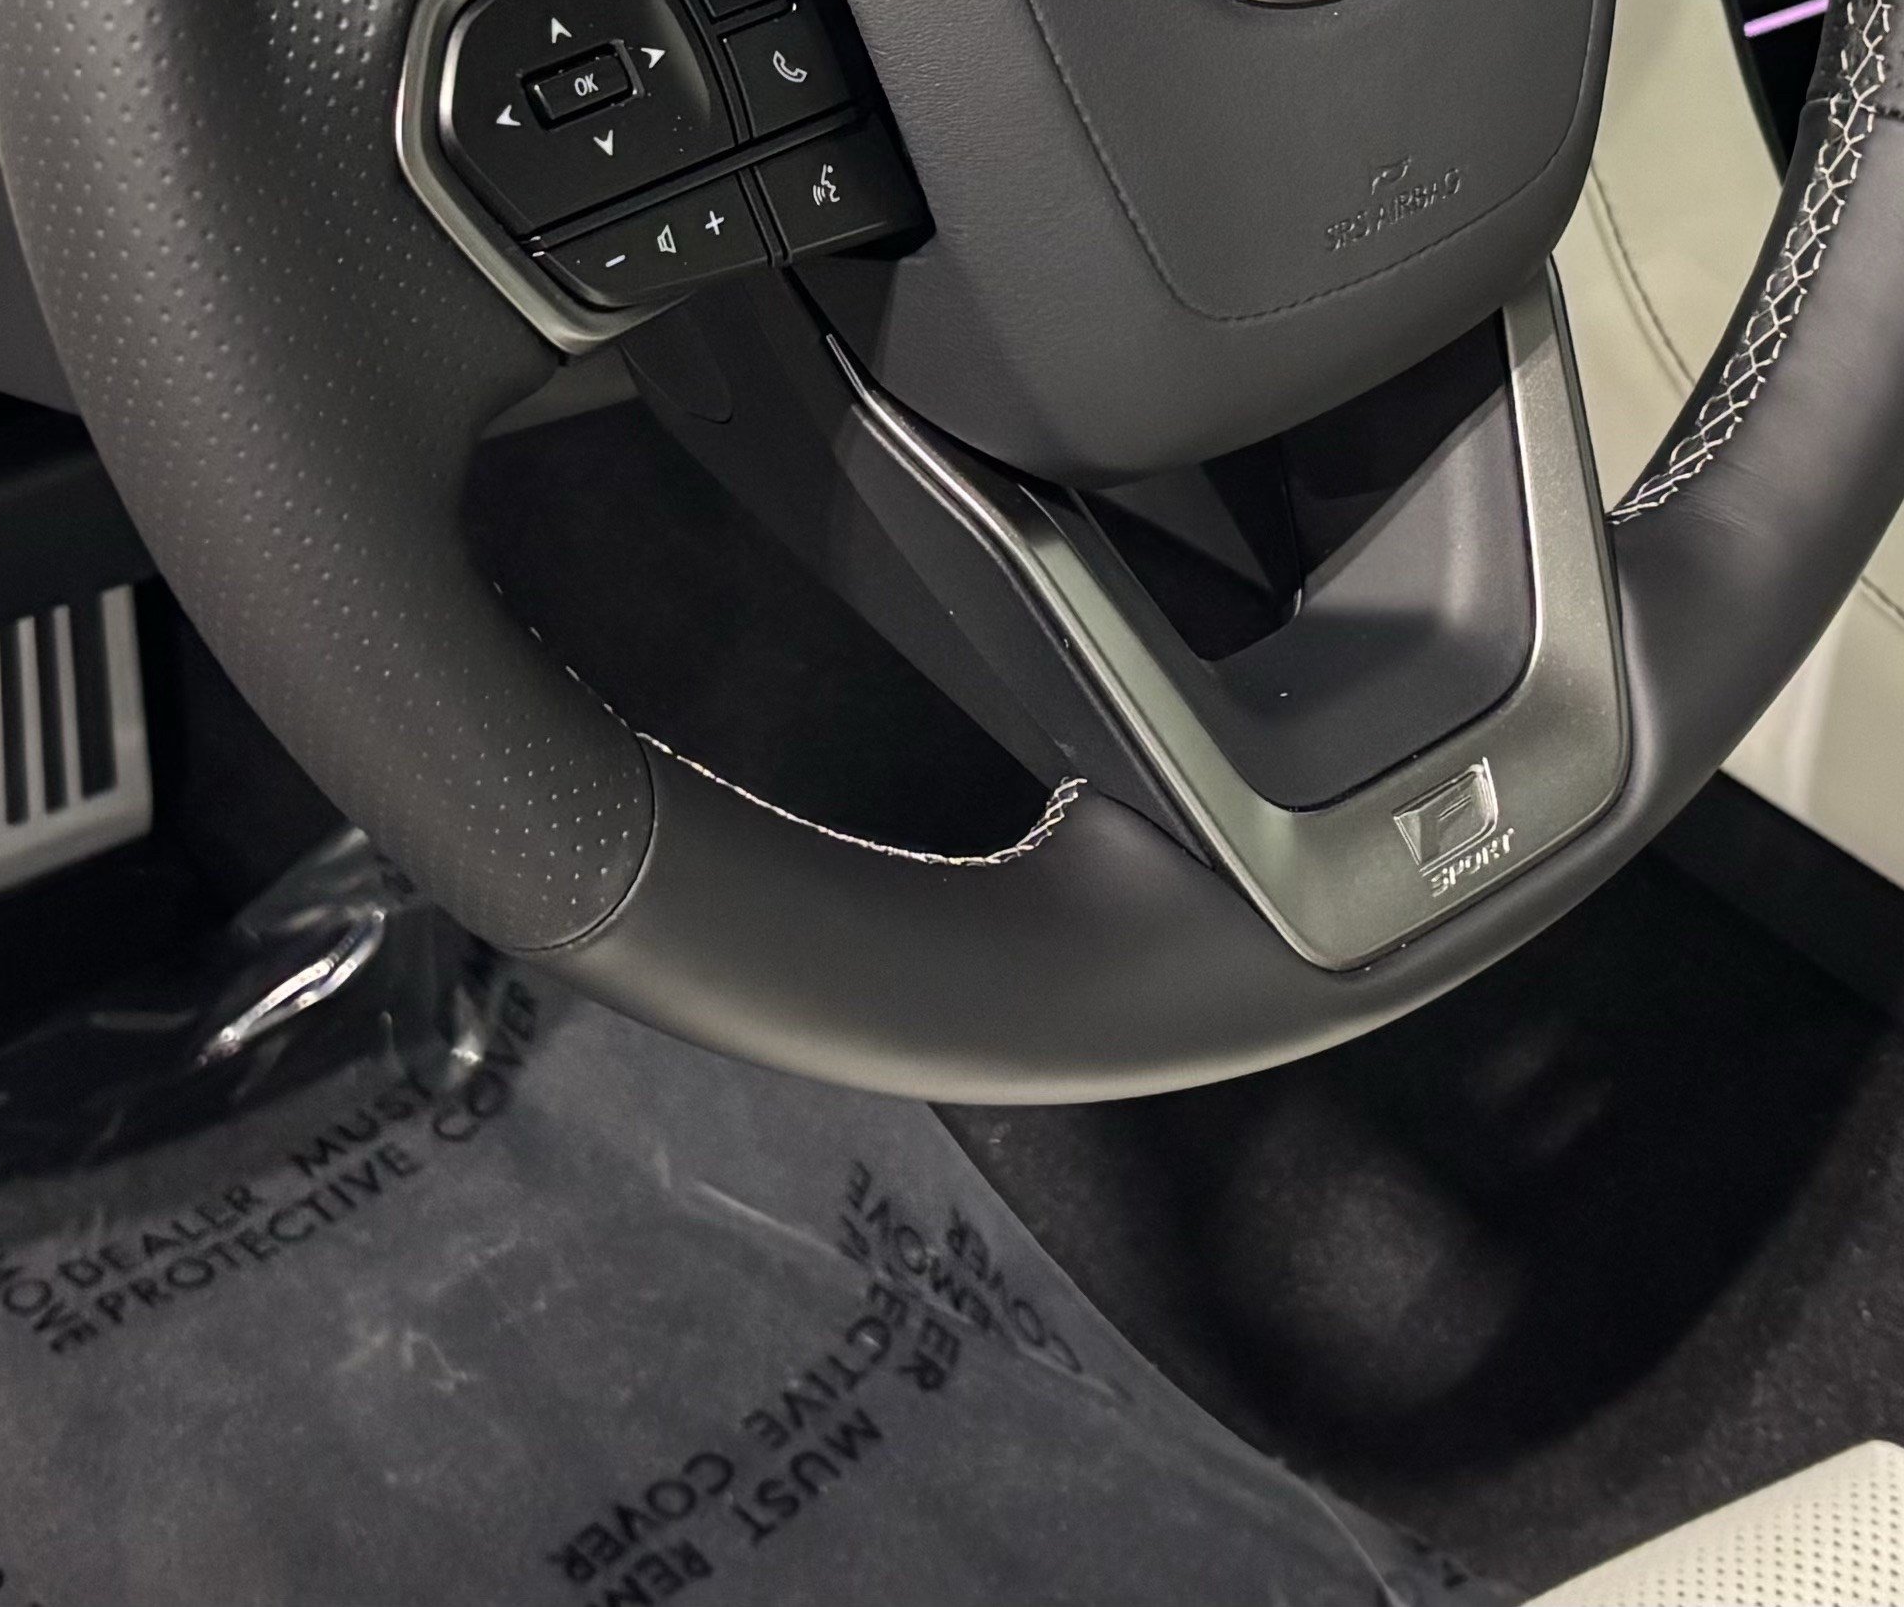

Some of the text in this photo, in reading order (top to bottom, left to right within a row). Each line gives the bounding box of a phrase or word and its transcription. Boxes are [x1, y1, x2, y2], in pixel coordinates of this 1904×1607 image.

[573, 73, 599, 97] OK
[1431, 826, 1516, 899] SPORT
[58, 1182, 268, 1290] DEALER
[96, 1142, 424, 1326] PROTECTIVE
[545, 1450, 736, 1587] COVER
[730, 1404, 884, 1551] MUST
[586, 1536, 718, 1607] REM
